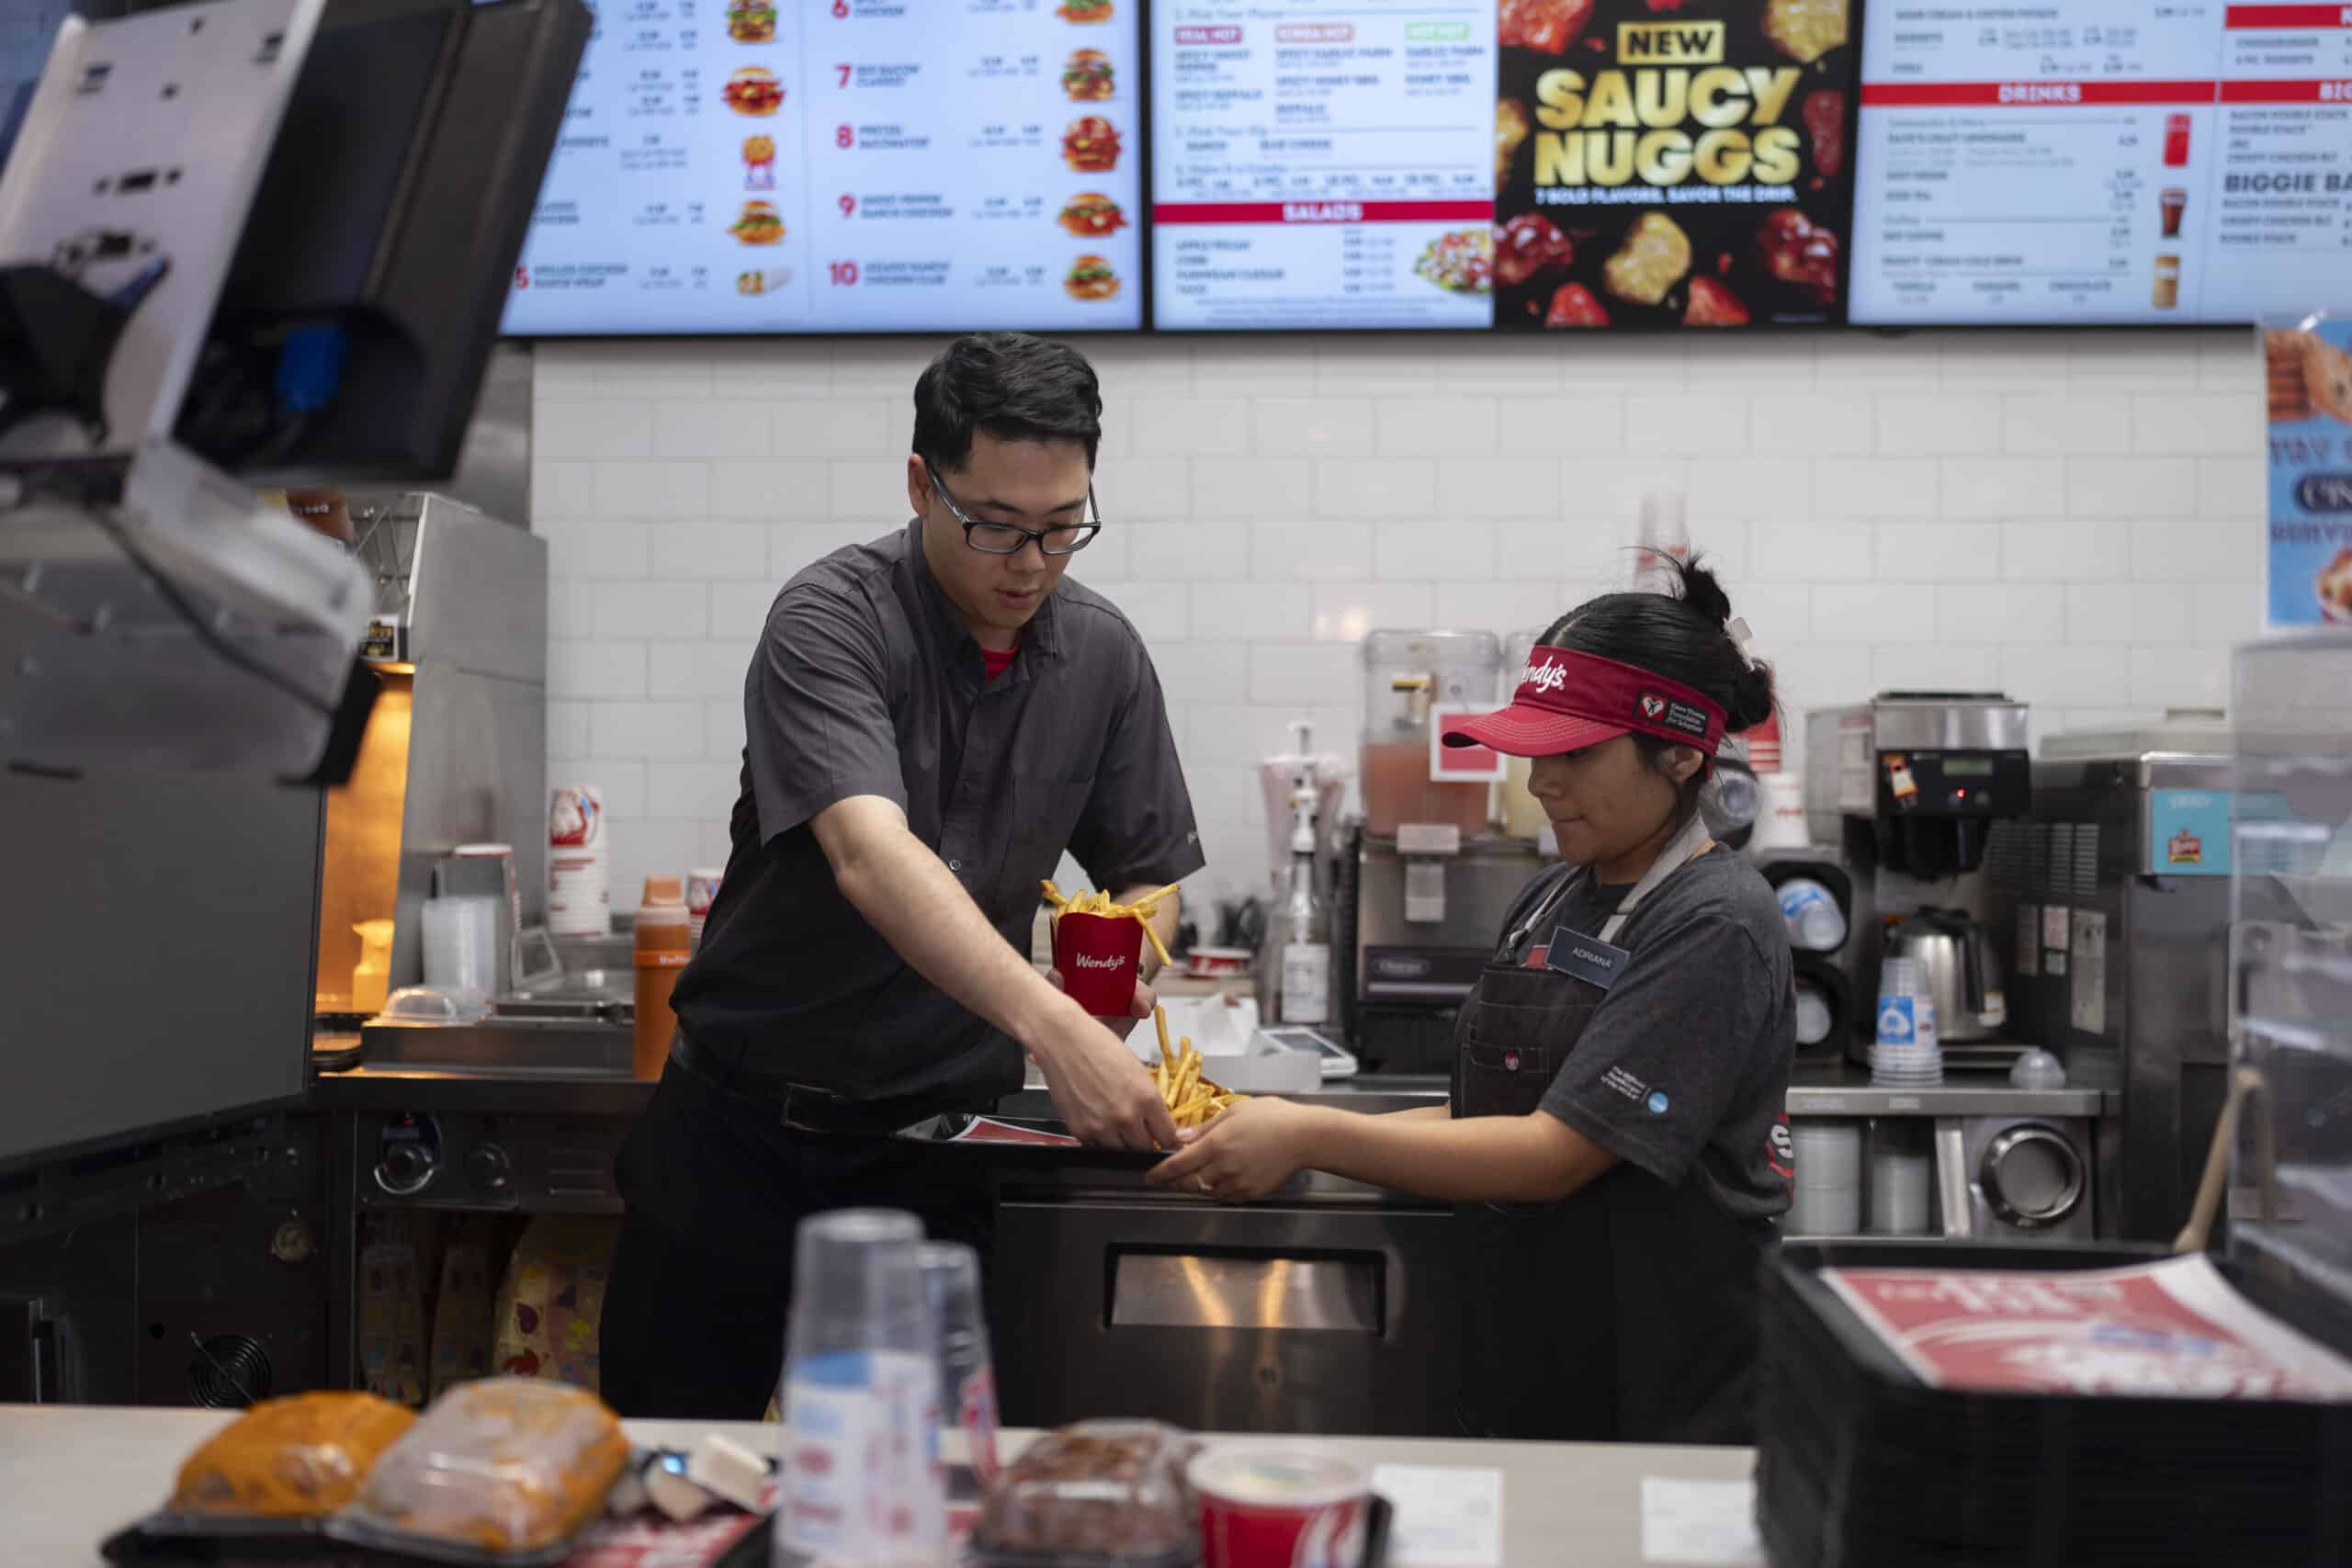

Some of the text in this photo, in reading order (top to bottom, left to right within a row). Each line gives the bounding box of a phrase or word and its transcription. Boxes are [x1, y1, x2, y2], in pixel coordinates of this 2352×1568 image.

[1627, 29, 1714, 56] NEW
[835, 65, 853, 88] 7
[1535, 67, 1803, 129] SAUCY
[1997, 83, 2081, 103] DRINKS
[837, 125, 854, 149] 8
[1534, 127, 1802, 186] NUGGS
[1547, 186, 1589, 204] BOLD
[1668, 186, 1721, 203] SAVOR
[1724, 186, 1752, 202] THE
[2223, 175, 2316, 193] BIGGIE
[839, 195, 855, 220] 9
[1282, 203, 1363, 221] SALADS
[831, 262, 859, 286] 10
[1076, 951, 1125, 971] Wendy's
